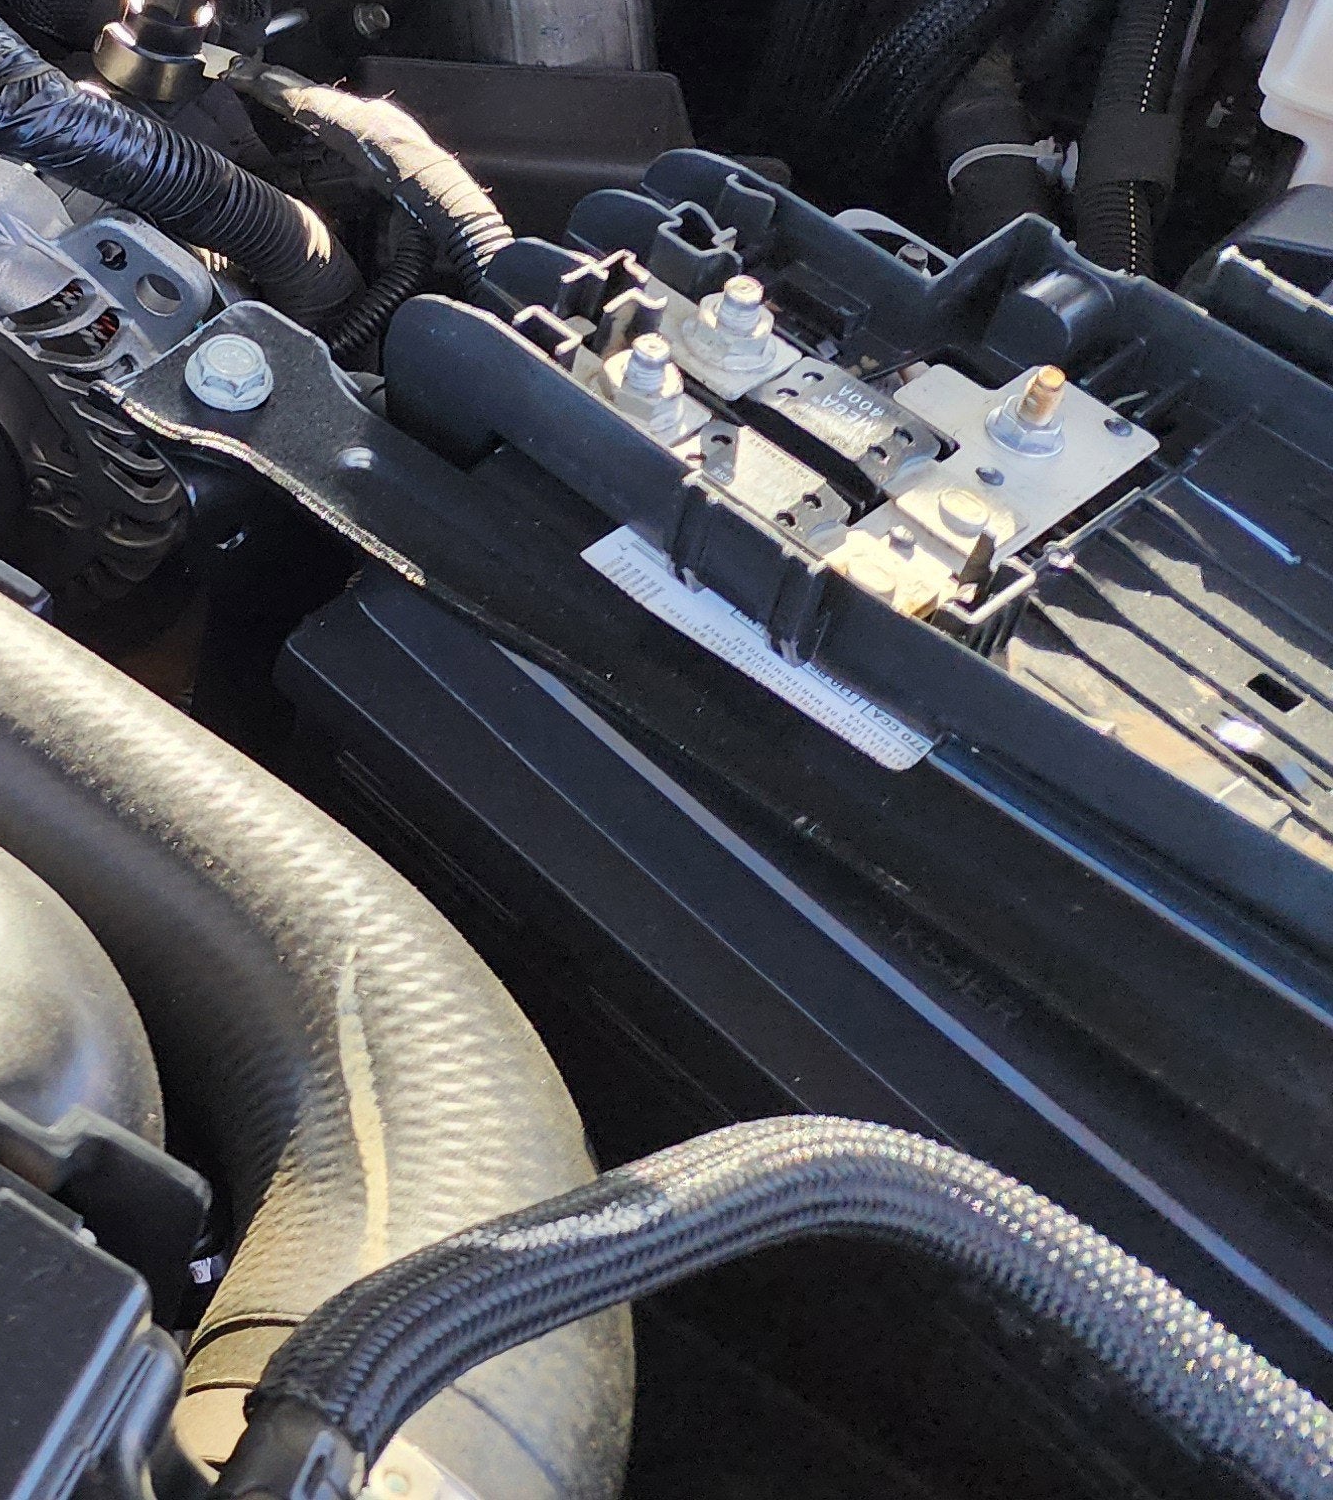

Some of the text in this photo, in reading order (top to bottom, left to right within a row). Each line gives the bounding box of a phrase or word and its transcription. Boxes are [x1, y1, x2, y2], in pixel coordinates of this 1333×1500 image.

[837, 385, 886, 418] 400A
[870, 708, 926, 753] 770 CCA
